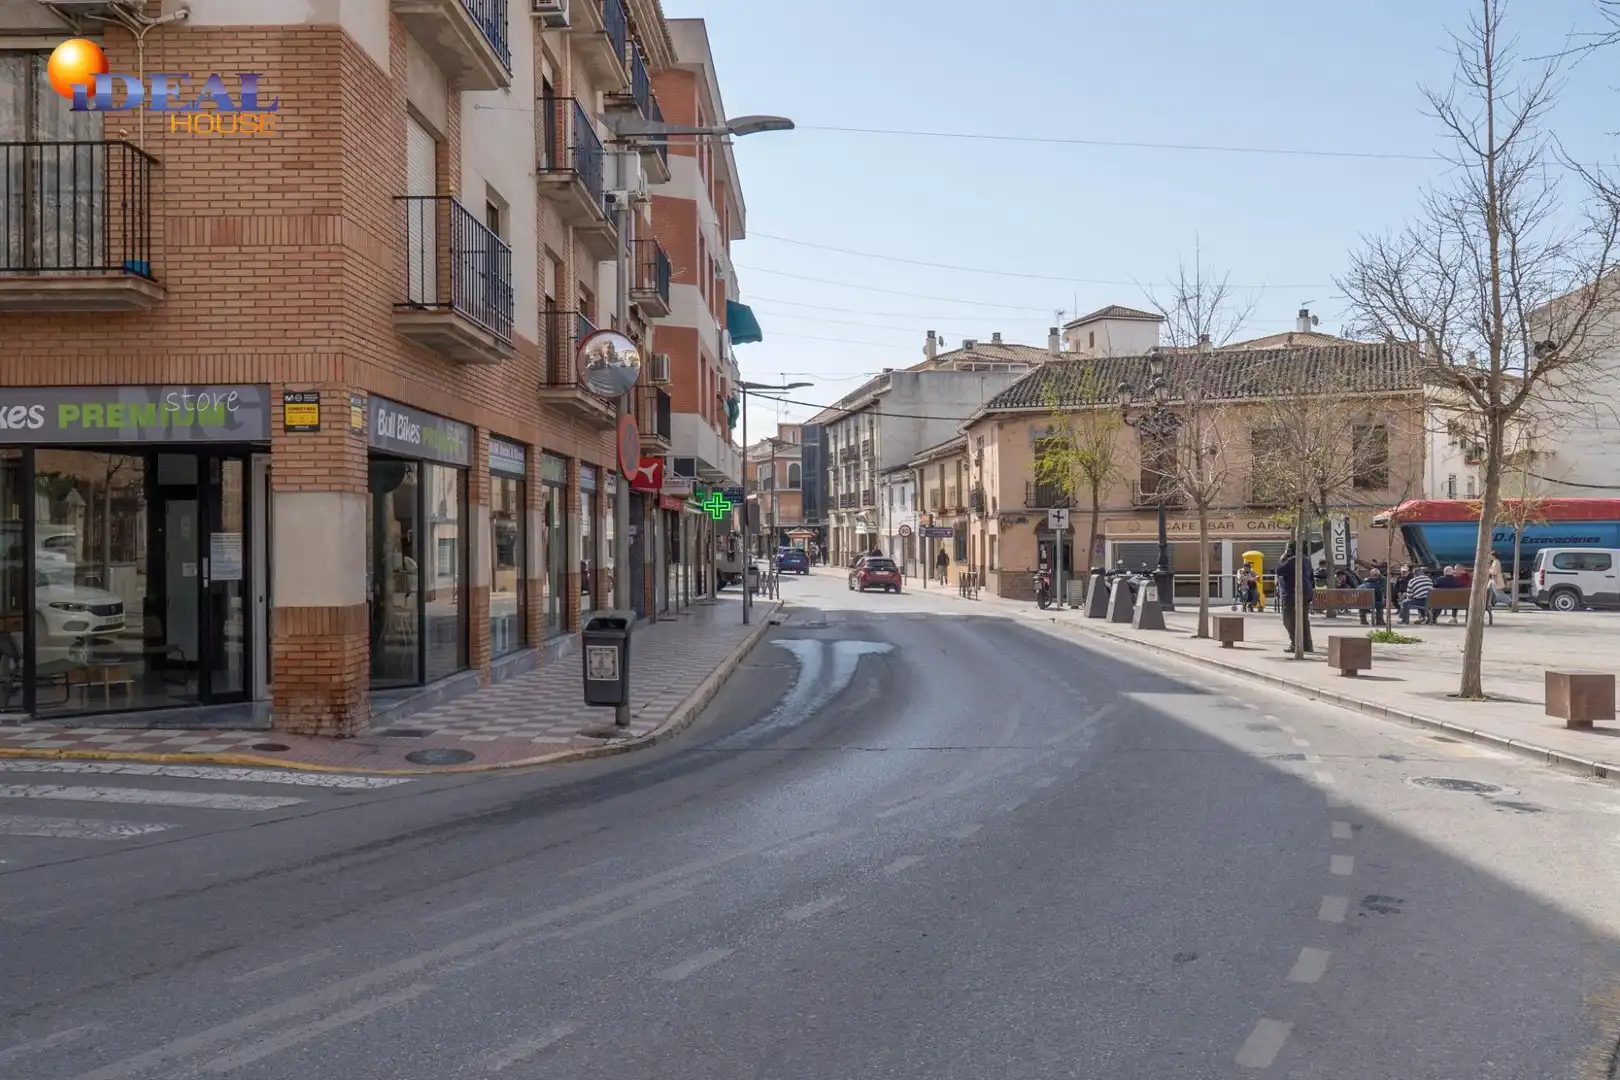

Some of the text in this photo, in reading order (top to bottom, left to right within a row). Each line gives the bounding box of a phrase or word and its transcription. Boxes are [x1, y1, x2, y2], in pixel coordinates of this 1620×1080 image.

[164, 387, 240, 412] store
[57, 402, 226, 429] PREMIUM
[377, 408, 396, 438] Bull
[396, 413, 421, 445] Bikes
[1207, 521, 1235, 531] BAR
[1520, 534, 1601, 545] Excavaciones
